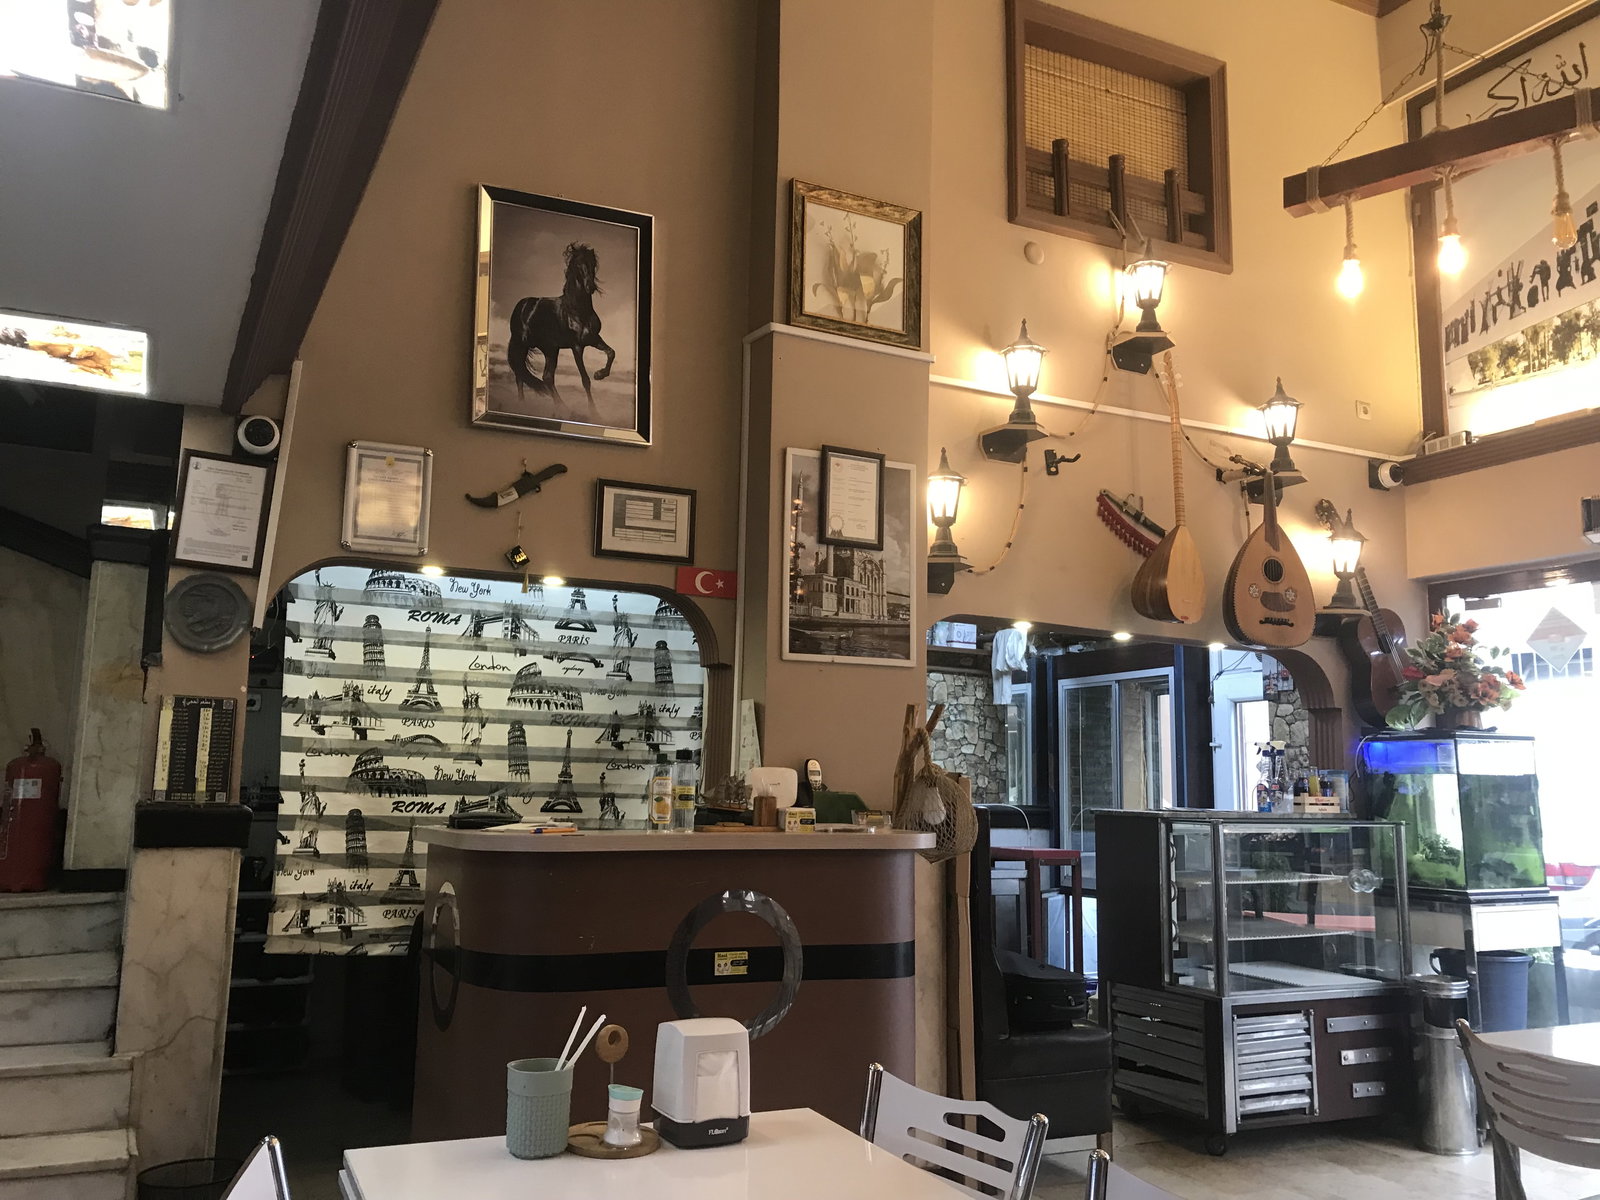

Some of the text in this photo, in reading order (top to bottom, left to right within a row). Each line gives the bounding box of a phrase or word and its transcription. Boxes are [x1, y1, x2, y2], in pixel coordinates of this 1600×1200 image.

[449, 577, 492, 599] New York
[407, 609, 463, 626] ROMA
[468, 654, 512, 672] London
[366, 684, 393, 702] italy
[658, 703, 681, 719] italy
[433, 764, 477, 786] New York
[390, 800, 447, 815] ROMA
[349, 878, 374, 897] italy
